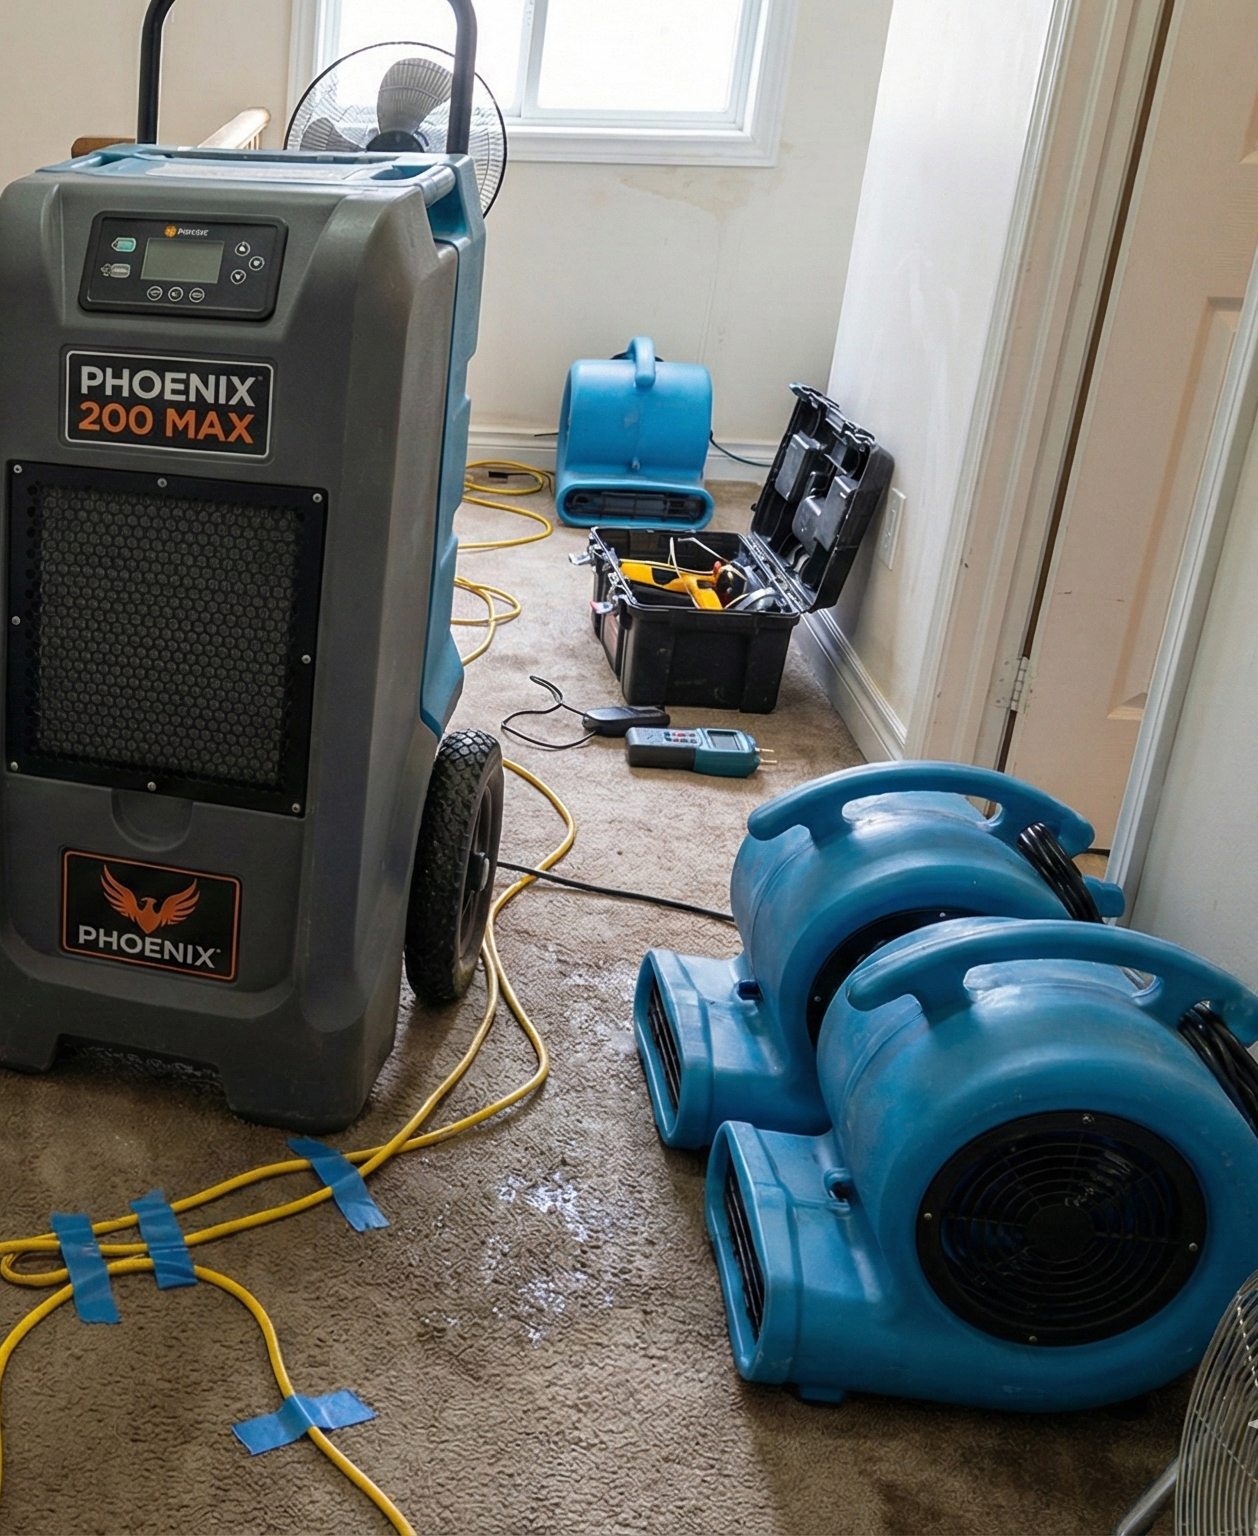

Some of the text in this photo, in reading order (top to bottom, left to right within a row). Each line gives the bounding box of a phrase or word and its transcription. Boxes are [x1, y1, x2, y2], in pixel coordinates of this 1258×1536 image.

[80, 365, 257, 407] PHOENIX
[78, 400, 255, 444] 200 MAX
[78, 924, 216, 969] PHOENIX
